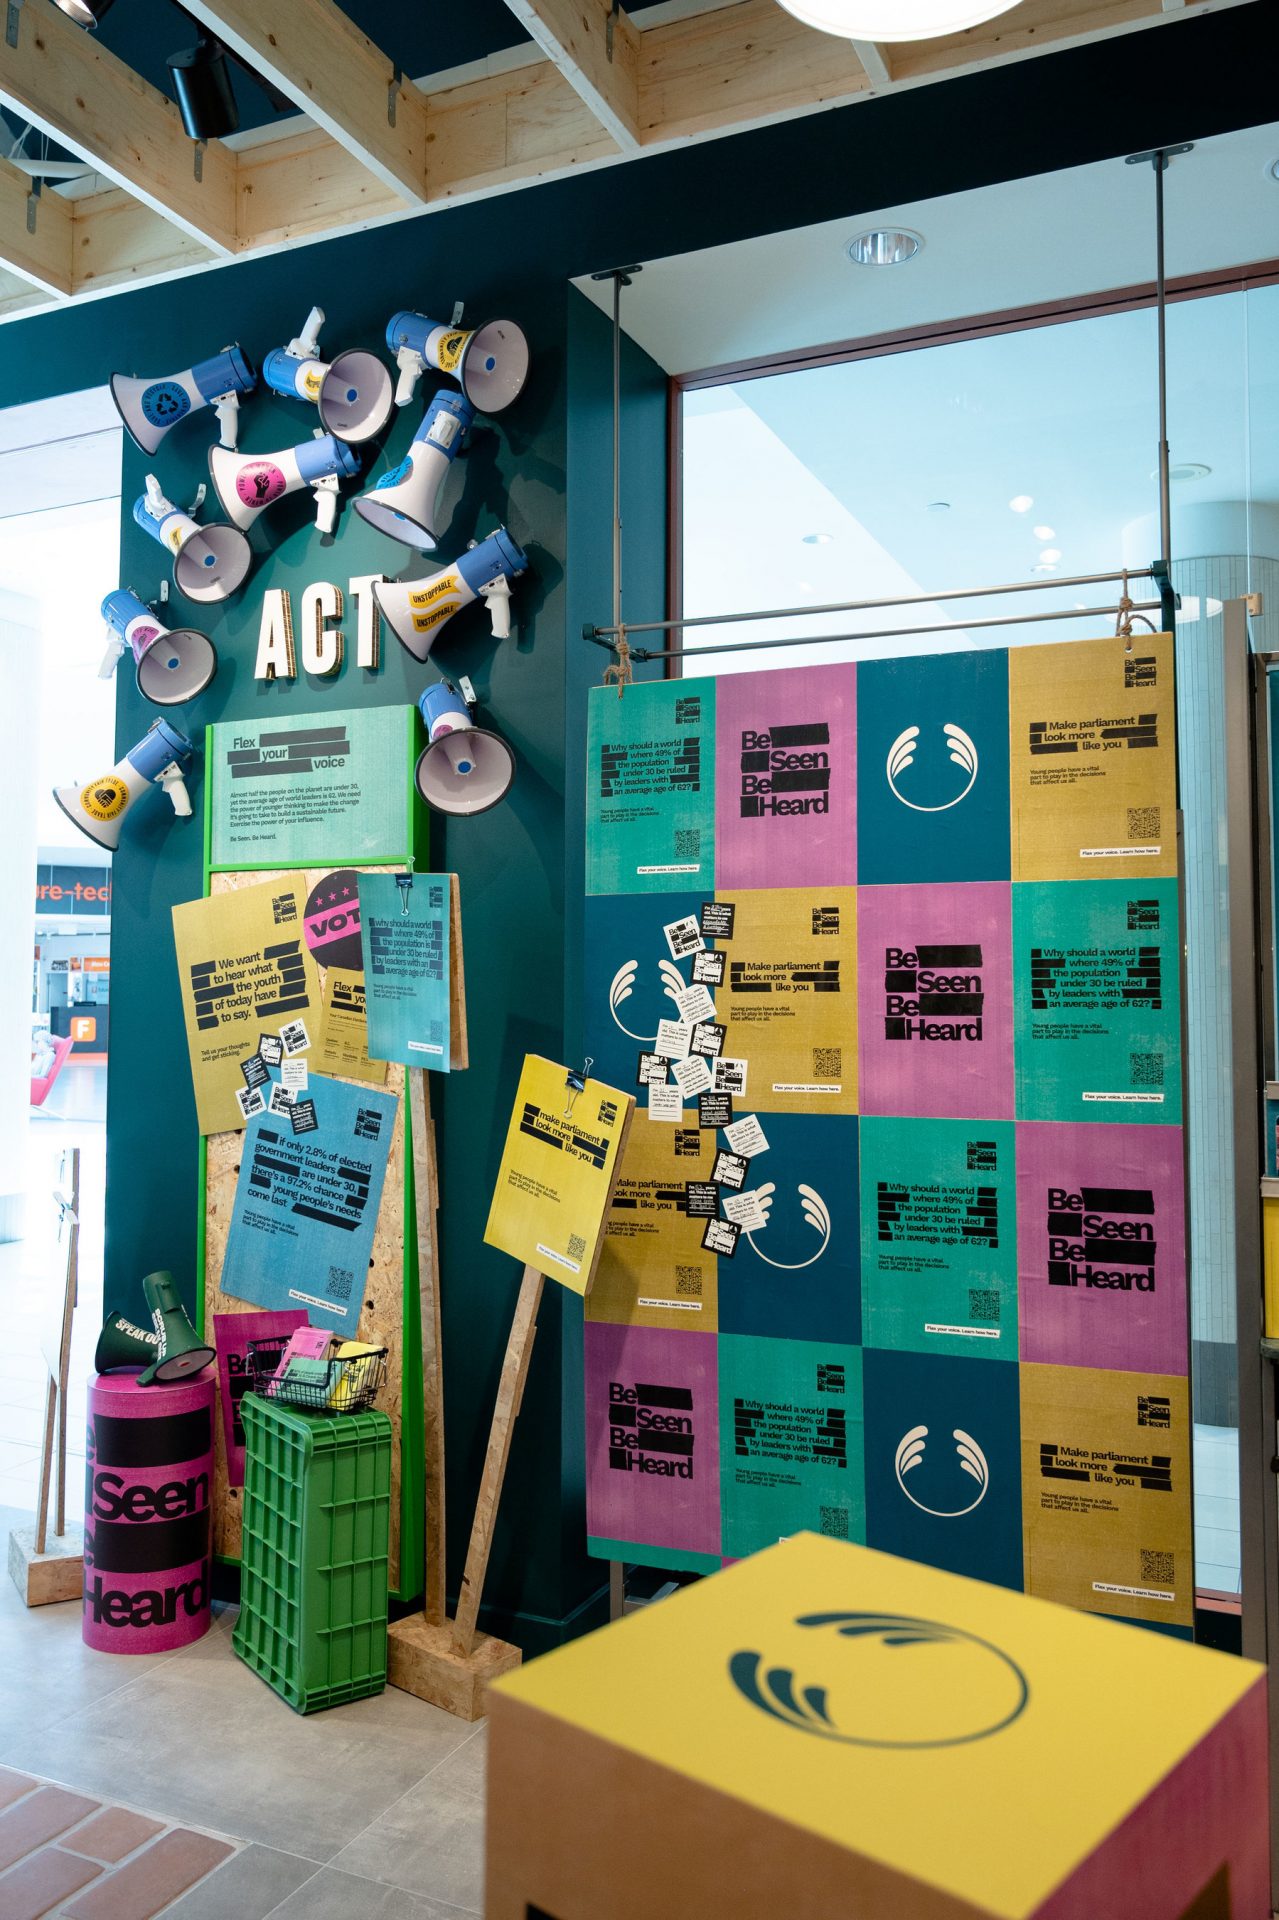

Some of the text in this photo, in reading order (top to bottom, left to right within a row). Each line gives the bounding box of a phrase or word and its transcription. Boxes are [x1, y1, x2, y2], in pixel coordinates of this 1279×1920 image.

[413, 580, 452, 603] UNSTOPPABLE
[417, 606, 453, 627] UNSTOPPABLE
[254, 574, 383, 680] ACT
[1050, 717, 1135, 730] Make parliament
[234, 737, 255, 749] Flex
[742, 731, 770, 750] Be
[1045, 731, 1095, 741] look more
[1083, 741, 1121, 751] like you
[262, 748, 287, 762] your
[314, 756, 345, 768] voice
[770, 751, 828, 771] Seen
[742, 775, 772, 795] Be
[760, 791, 828, 816] Heard
[36, 882, 112, 901] re-tec
[310, 908, 361, 937] VOT
[219, 952, 261, 969] We want
[886, 948, 918, 968] Be
[1044, 949, 1063, 959] Why
[1109, 948, 1135, 956] world
[1125, 958, 1135, 966] of
[214, 963, 273, 984] to hear what
[748, 962, 821, 972] Make parliament
[1071, 969, 1120, 978] population
[236, 974, 281, 992] the youth
[333, 981, 352, 992] Flex
[776, 983, 809, 993] like you
[918, 971, 981, 992] Seen
[1090, 979, 1101, 987] 30
[1118, 979, 1142, 987] ruled
[215, 989, 277, 1010] of today have
[1049, 990, 1060, 999] by
[1099, 989, 1120, 997] with
[886, 995, 919, 1016] Be
[1063, 1001, 1098, 1009] average
[1101, 1001, 1117, 1009] age
[221, 1010, 251, 1024] to say.
[77, 1020, 89, 1039] F
[906, 1018, 982, 1041] Heard
[358, 1108, 367, 1116] Be
[364, 1117, 381, 1127] Seen
[356, 1121, 365, 1130] Be
[359, 1130, 378, 1141] Heard
[536, 1119, 571, 1142] look more
[540, 1111, 600, 1145] make parliament
[255, 1143, 336, 1174] government leaders
[279, 1136, 372, 1172] if only 2.8% of elected
[565, 1143, 592, 1162] like you
[252, 1164, 279, 1181] there's
[287, 1176, 312, 1191] 97.2%
[314, 1185, 344, 1201] chance
[302, 1170, 356, 1195] are under 30,
[248, 1188, 287, 1207] come last
[273, 1185, 362, 1219] young people's needs
[1048, 1188, 1083, 1211] Be
[1083, 1215, 1153, 1240] Seen
[1049, 1238, 1085, 1262] Be
[1071, 1264, 1155, 1292] Heard
[116, 1318, 161, 1345] SPEAK OU
[609, 1382, 637, 1404] Be
[637, 1408, 692, 1433] Seen
[610, 1427, 639, 1449] Be
[627, 1451, 693, 1479] Heard
[1056, 1457, 1107, 1471] look more
[1061, 1447, 1148, 1464] Make parliament
[1095, 1473, 1134, 1486] like you
[93, 1472, 209, 1522] Seen
[83, 1559, 207, 1628] Heard
